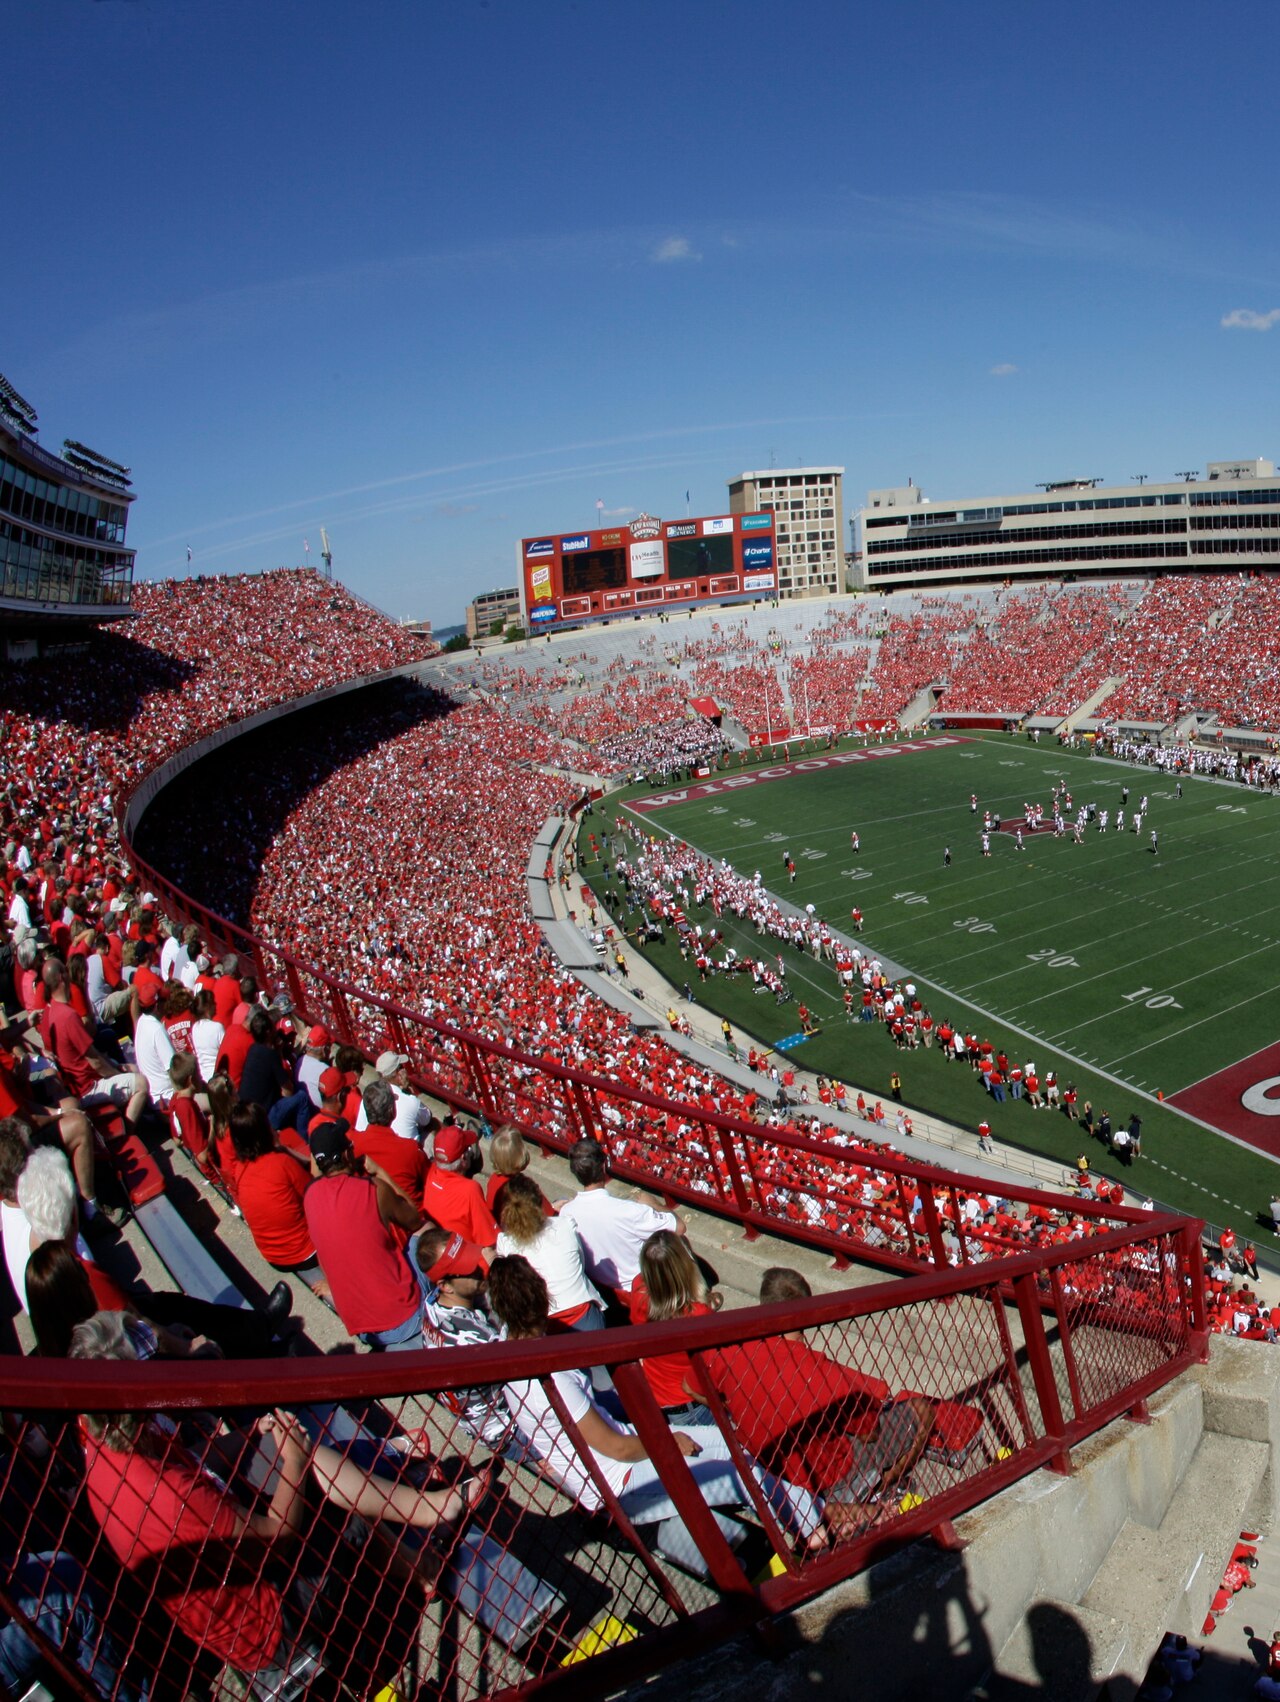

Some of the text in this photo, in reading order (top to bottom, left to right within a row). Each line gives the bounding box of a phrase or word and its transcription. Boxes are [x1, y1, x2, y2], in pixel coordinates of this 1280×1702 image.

[562, 537, 589, 551] StubHub!
[750, 547, 771, 555] Charter
[637, 736, 960, 806] WISCONSIN
[893, 891, 927, 905] 40
[953, 916, 994, 934] 30
[1026, 948, 1076, 968] 20
[1121, 986, 1176, 1010] 10
